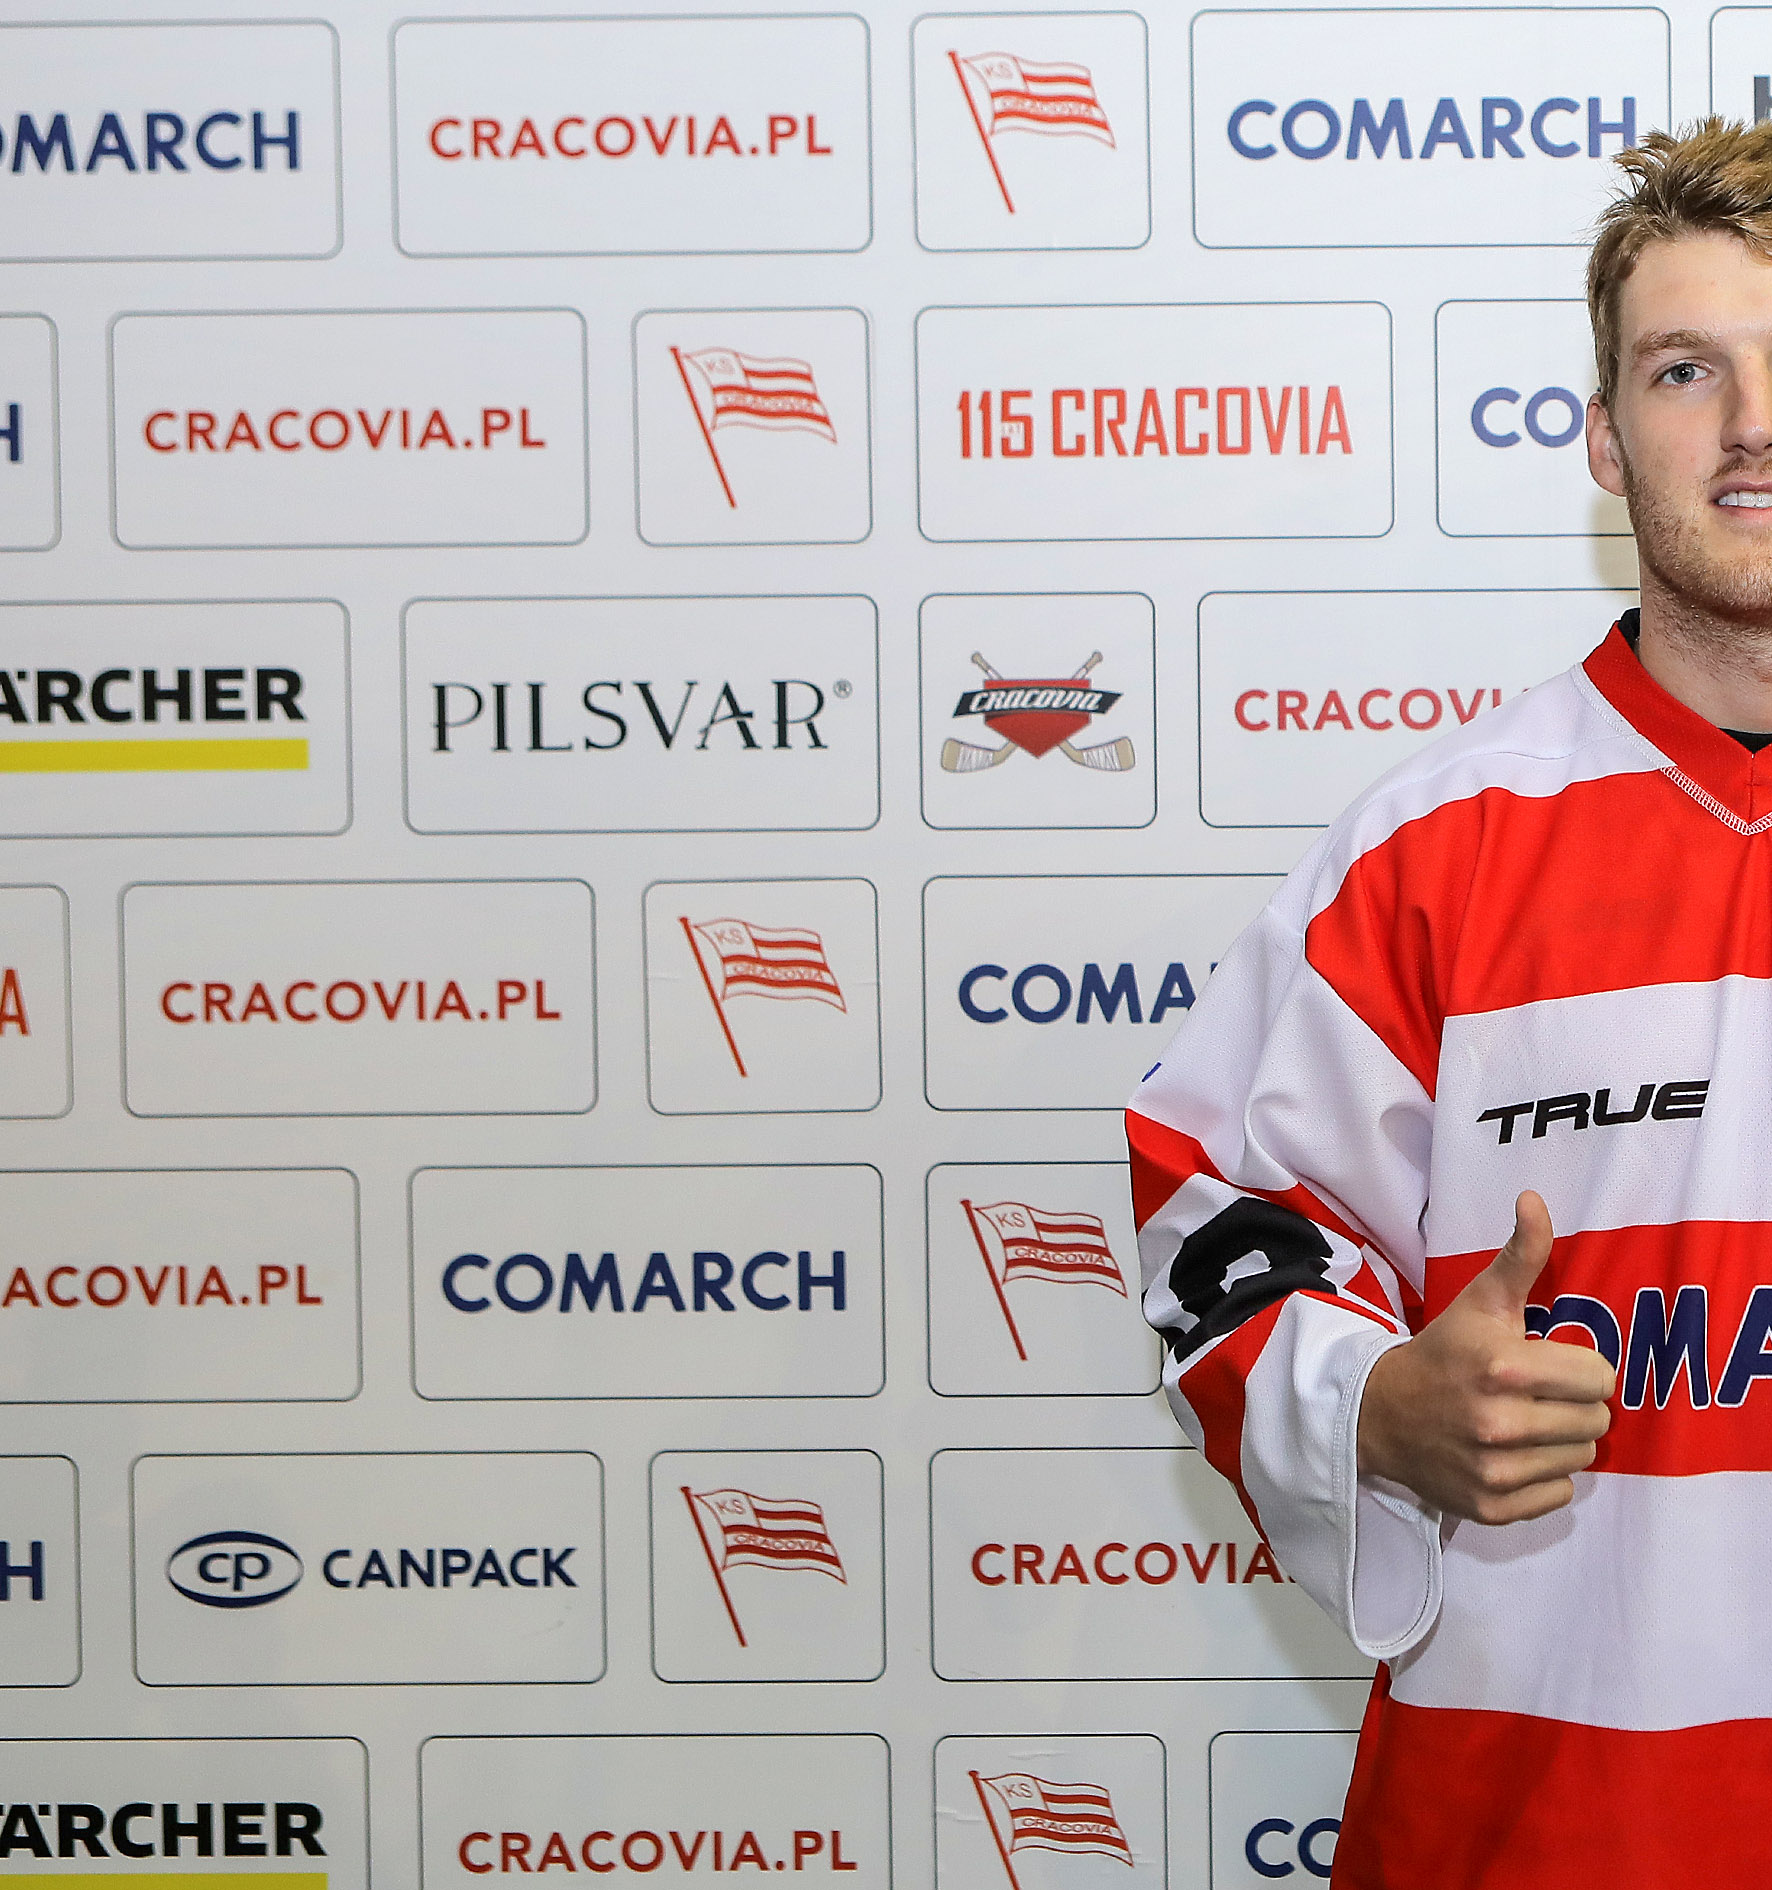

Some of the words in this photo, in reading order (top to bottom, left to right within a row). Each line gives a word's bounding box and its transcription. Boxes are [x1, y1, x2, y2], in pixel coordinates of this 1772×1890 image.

[983, 63, 1013, 81] KS
[0, 110, 299, 174] MARCH
[428, 115, 832, 160] CRACOVIA.PL
[1227, 97, 1636, 161] COMARCH
[144, 408, 546, 453] CRACOVIA.PL
[958, 389, 1034, 459] 115
[1052, 385, 1353, 457] CRACOVIA
[1471, 387, 1585, 448] CO
[1234, 688, 1530, 731] CRACOV
[712, 929, 745, 947] KS
[730, 962, 825, 983] CRACOVIA
[958, 963, 1218, 1024] COMA
[161, 980, 561, 1024] CRACOVIA.PL
[1476, 1080, 1711, 1145] TRUE
[994, 1210, 1025, 1228] KS
[1013, 1245, 1107, 1266] CRACOVIA
[2, 1264, 322, 1309] ACOVIA.PL
[442, 1251, 847, 1313] COMARCH
[715, 1499, 746, 1517] KS
[733, 1533, 826, 1555] CRACOVIA
[323, 1548, 577, 1588] CANPACK
[1003, 1782, 1033, 1799] KS
[1021, 1816, 1113, 1836] CRACOVIA
[458, 1831, 858, 1874] CRACOVIA.PL
